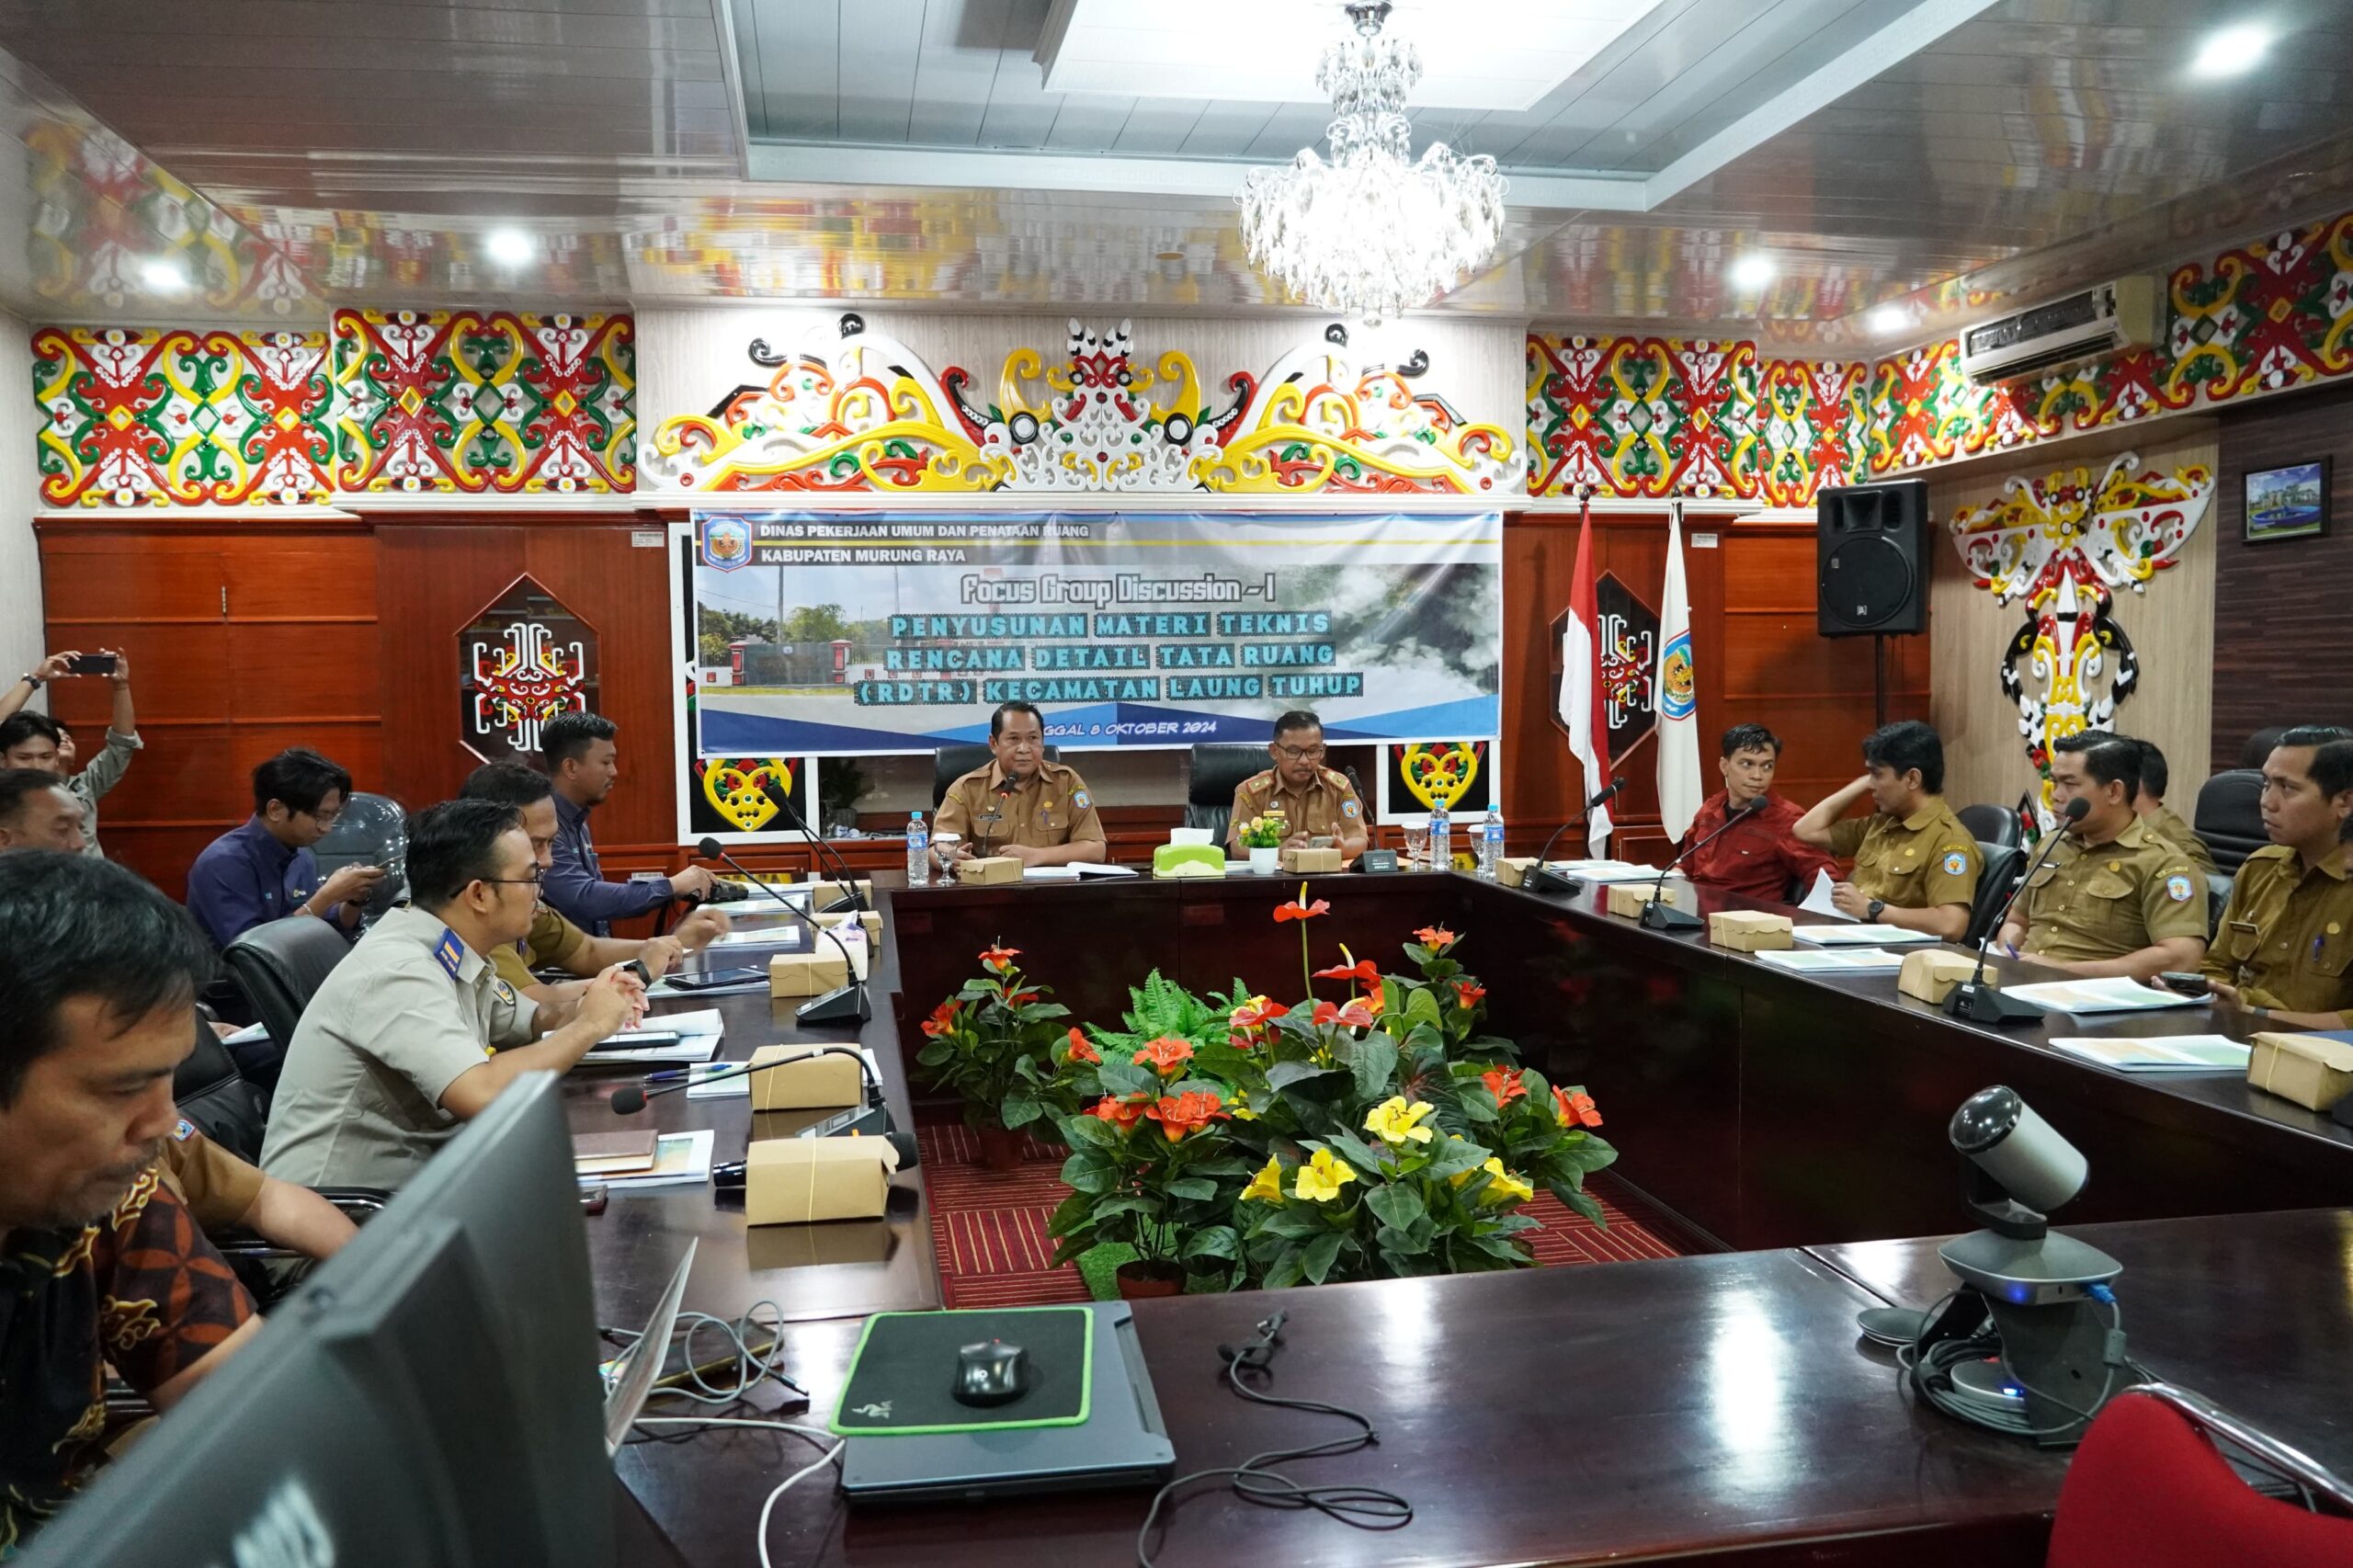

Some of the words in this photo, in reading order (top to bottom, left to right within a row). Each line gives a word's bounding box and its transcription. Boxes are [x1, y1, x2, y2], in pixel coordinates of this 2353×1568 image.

[760, 525, 804, 537] DINAS
[807, 525, 888, 537] PEKERJAAN
[891, 525, 934, 537] UMUM
[938, 525, 965, 537] DAN
[970, 525, 1039, 538] PENATAAN
[1042, 525, 1089, 538] RUANG
[761, 549, 852, 562] KABUPATEN
[855, 549, 922, 562] MURUNG
[926, 549, 965, 562] RAYA
[961, 574, 1037, 604] Focus
[1040, 574, 1113, 609] Group
[1116, 574, 1242, 603] Discussion
[892, 616, 1086, 637] PENYUSUNAN
[1097, 614, 1208, 636] MATERI
[1220, 613, 1329, 634] TEKNIS
[886, 648, 1023, 670] RENCANA
[1035, 646, 1147, 668] DETAIL
[1159, 644, 1233, 666] TATA
[1244, 644, 1333, 665] RUANG
[860, 682, 972, 703] (RDTR)
[986, 678, 1158, 701] KECAMATAN
[1169, 677, 1260, 697] LAUNG
[1272, 675, 1360, 696] TUHUP
[1043, 722, 1086, 736] GGAL
[1090, 723, 1101, 735] 8
[1105, 722, 1178, 735] OKTOBER
[1182, 721, 1217, 733] 2024
